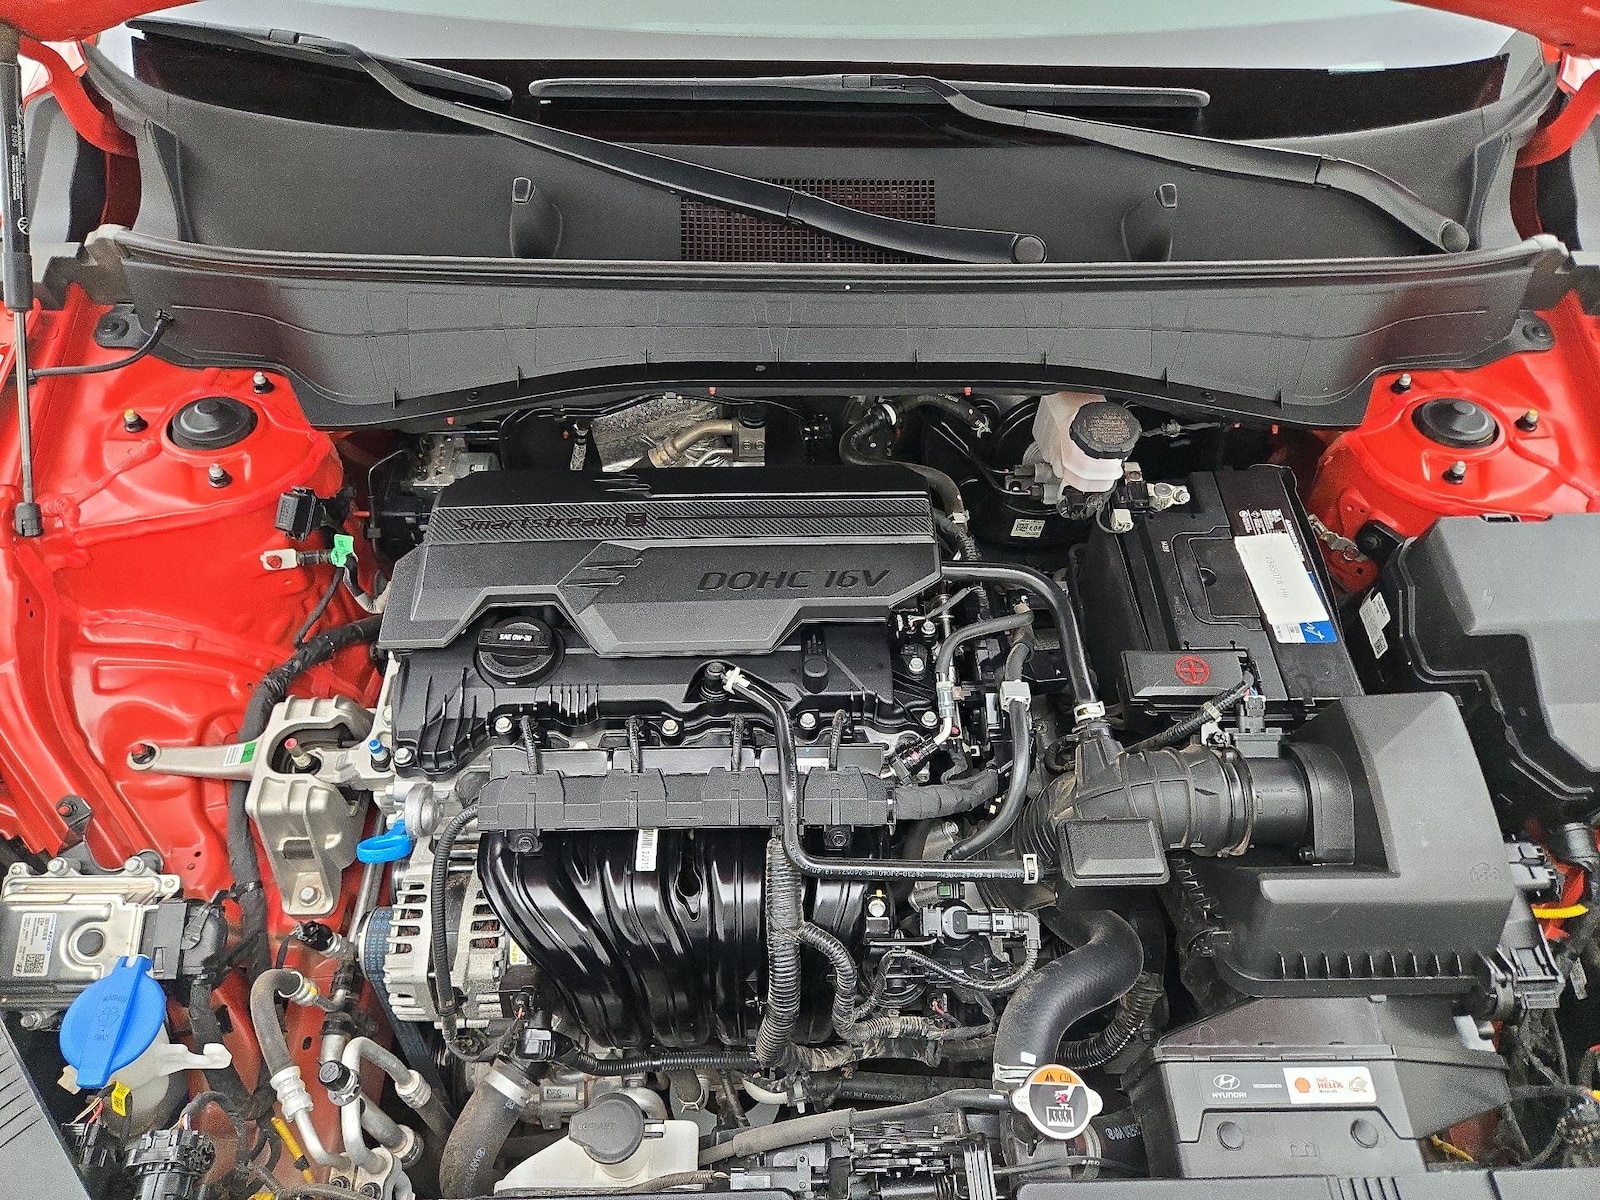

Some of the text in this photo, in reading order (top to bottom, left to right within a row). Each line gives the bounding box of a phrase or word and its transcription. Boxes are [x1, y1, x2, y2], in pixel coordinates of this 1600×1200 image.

[454, 515, 620, 530] Smartstream
[696, 569, 891, 592] DOHC 16V
[499, 633, 513, 641] SAE
